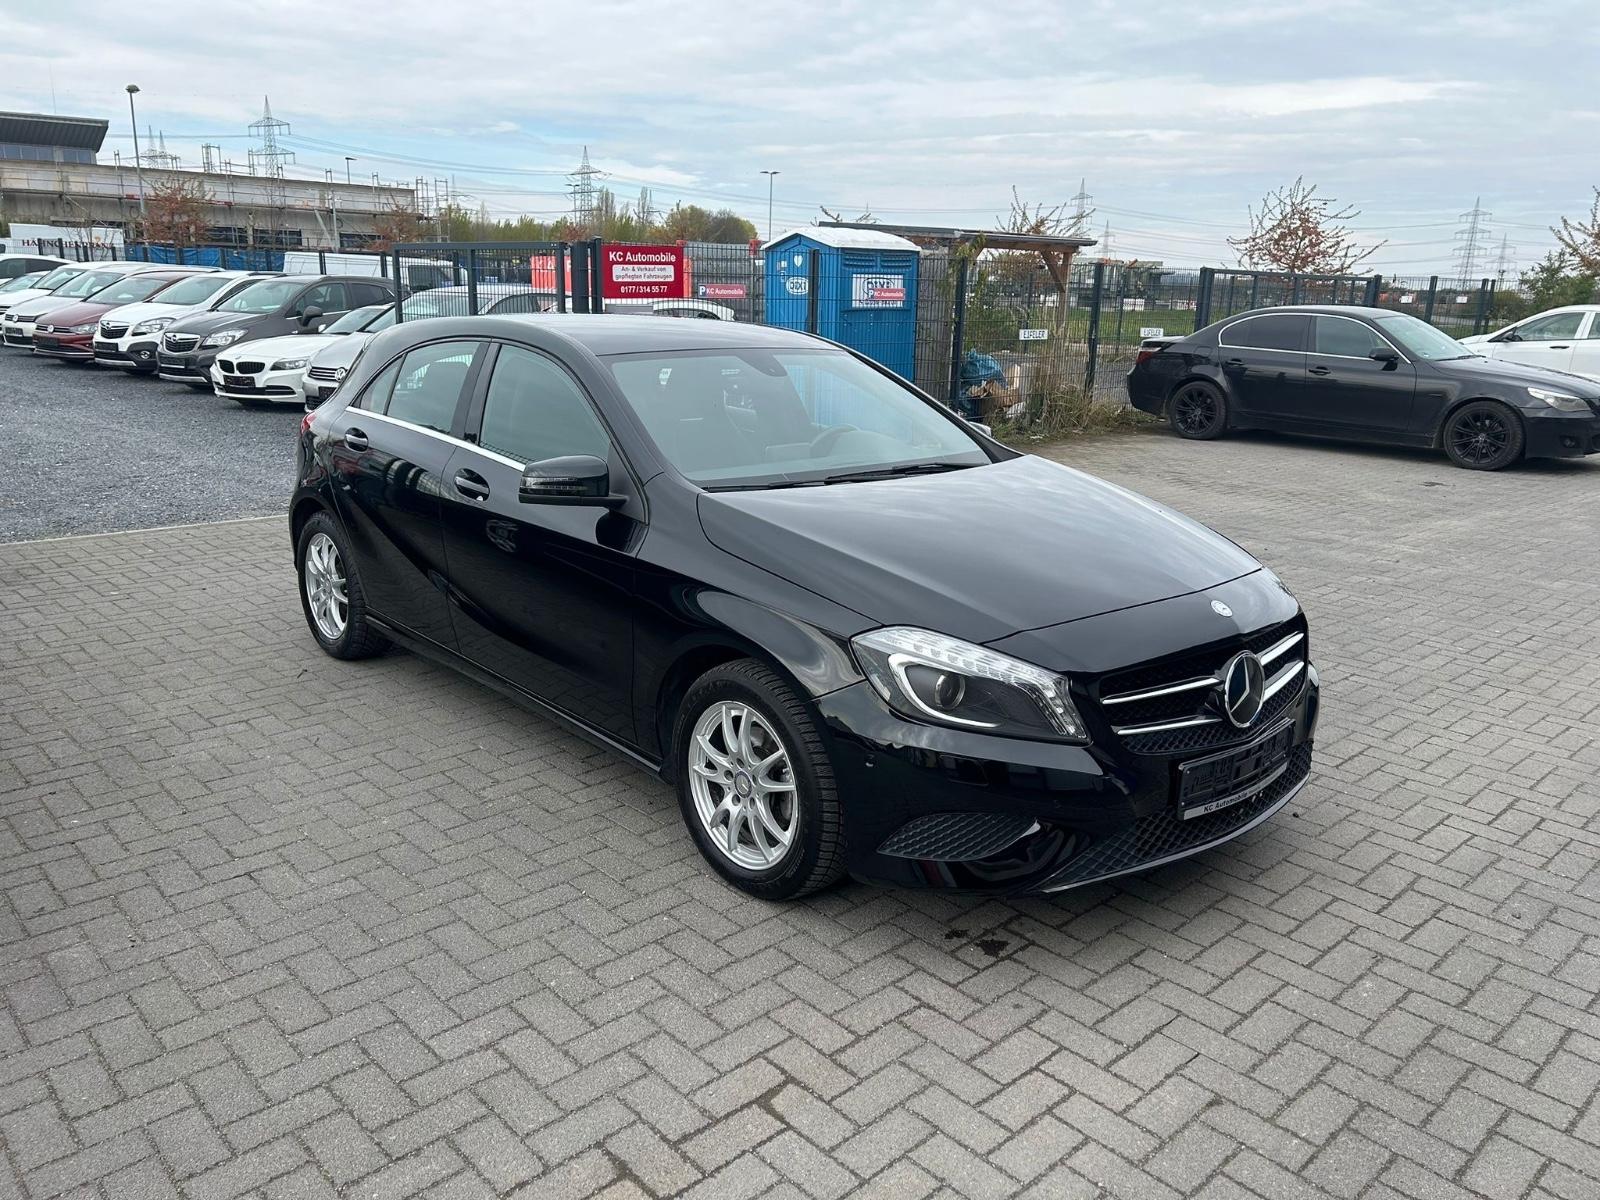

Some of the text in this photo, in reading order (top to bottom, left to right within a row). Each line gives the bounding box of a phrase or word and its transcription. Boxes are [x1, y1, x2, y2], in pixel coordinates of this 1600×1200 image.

[609, 251, 676, 262] KC Automobile
[615, 273, 672, 281] gepflegten Fahrzeugen
[652, 285, 659, 293] 55
[660, 285, 668, 293] 77
[707, 287, 715, 295] KC
[715, 287, 744, 295] Automobile
[1203, 791, 1248, 813] KC Automobile
